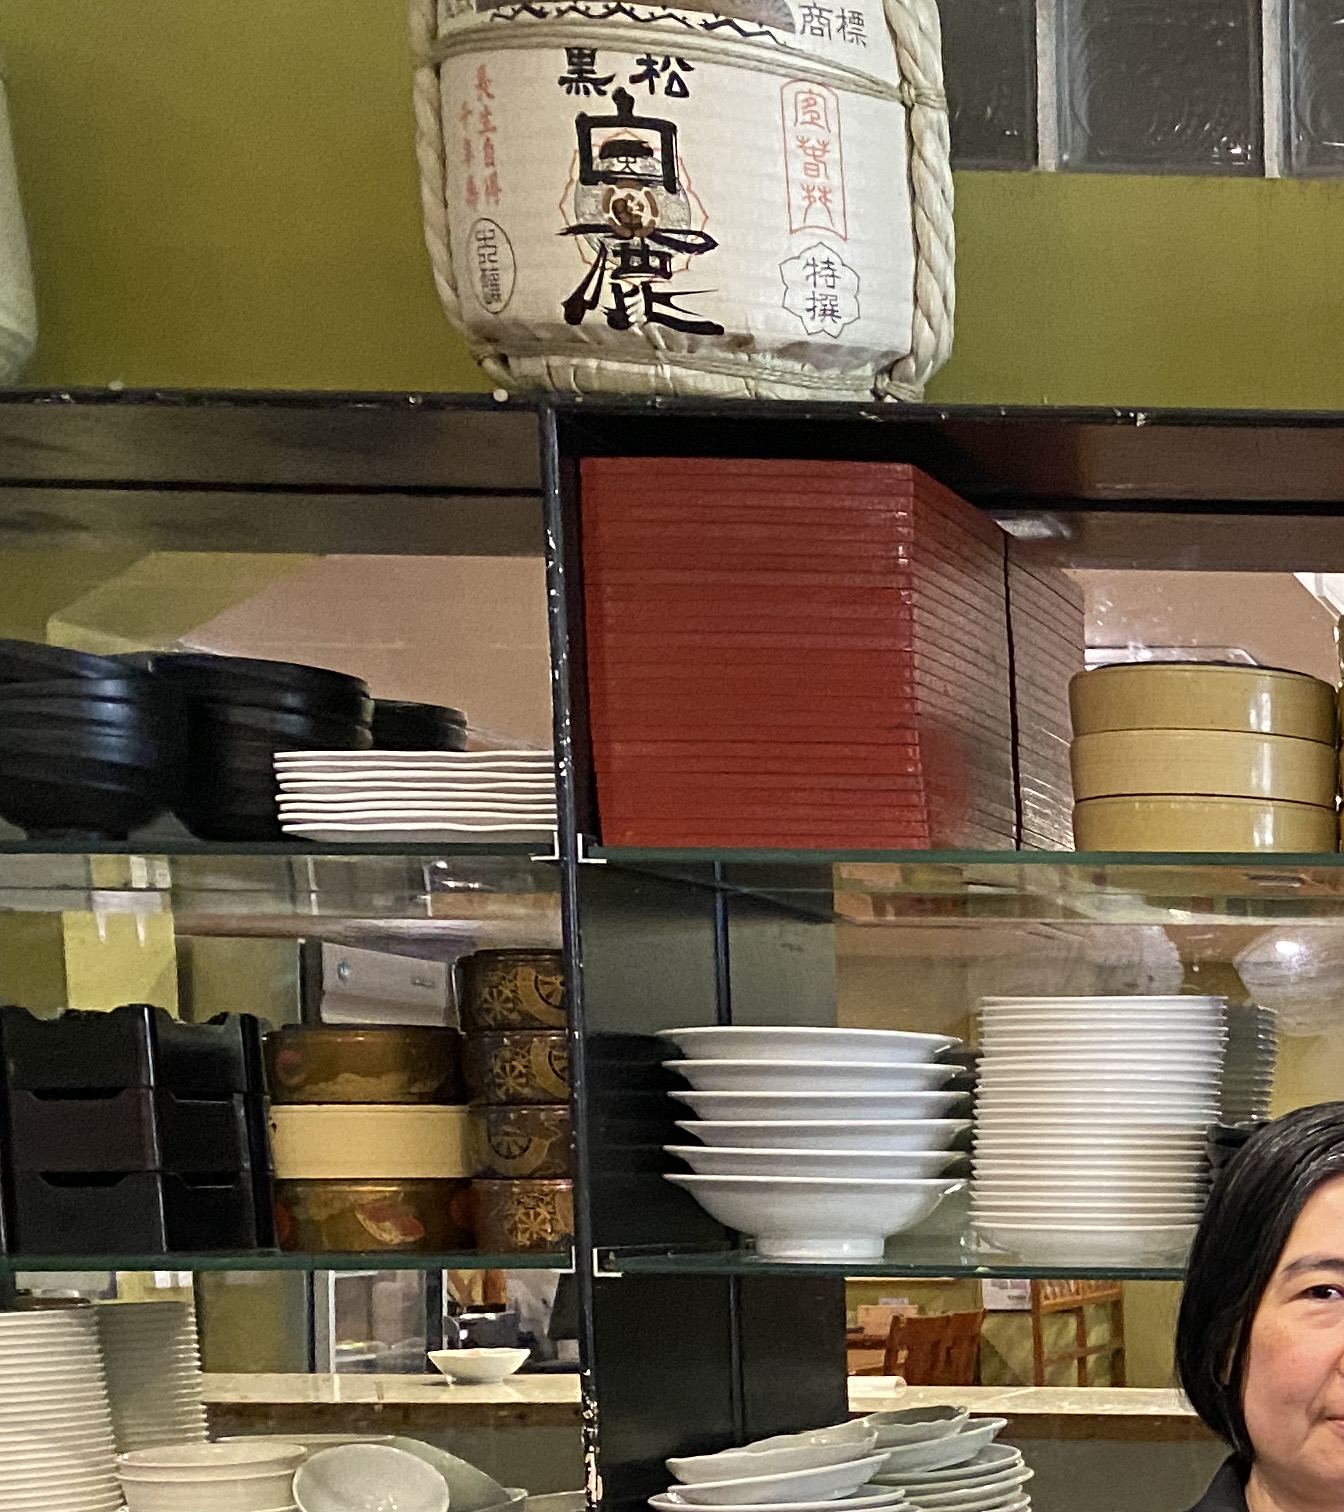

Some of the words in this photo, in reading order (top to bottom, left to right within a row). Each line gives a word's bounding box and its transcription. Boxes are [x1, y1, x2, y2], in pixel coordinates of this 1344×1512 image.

[798, 2, 868, 47] 商標
[557, 47, 695, 99] 黒松
[803, 256, 842, 324] 特撰
